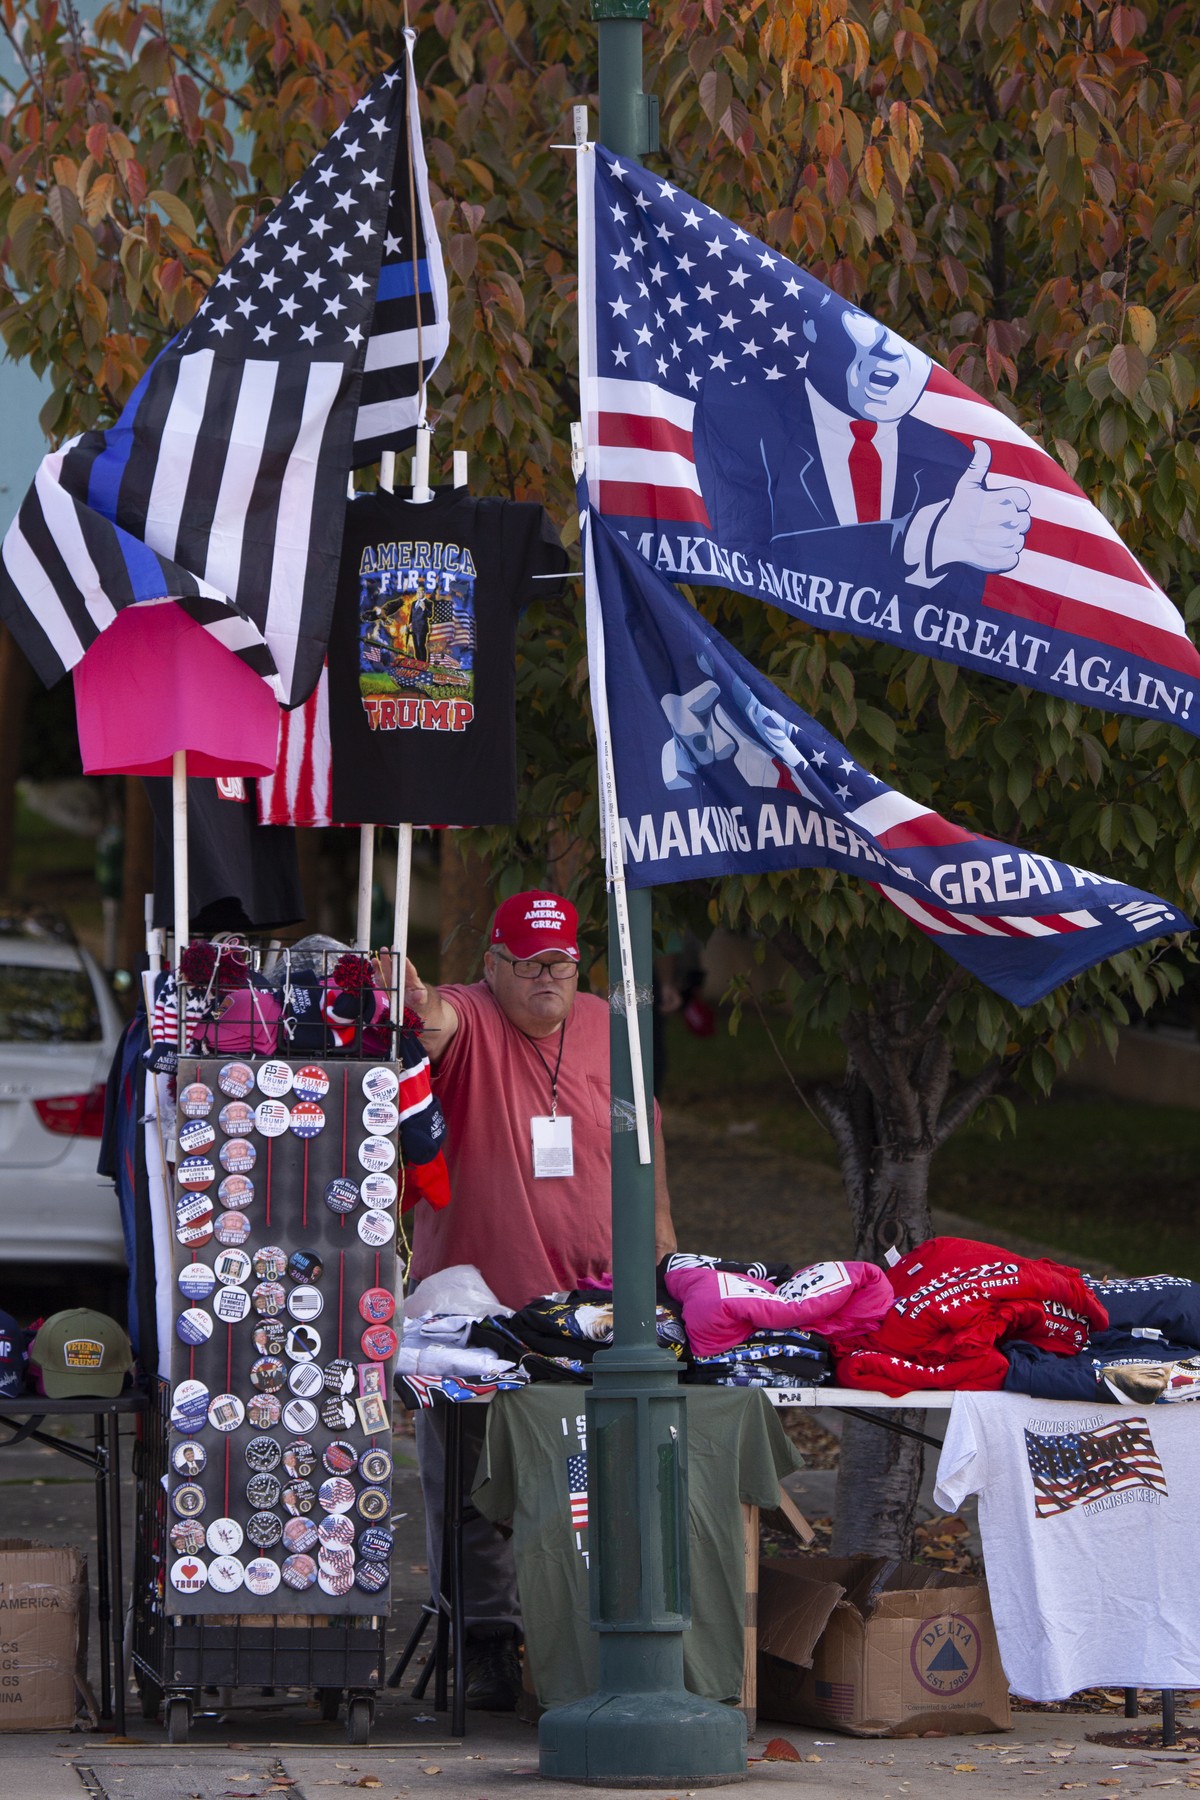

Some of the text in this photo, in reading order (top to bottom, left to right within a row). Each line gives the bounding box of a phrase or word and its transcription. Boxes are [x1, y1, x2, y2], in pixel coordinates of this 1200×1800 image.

[359, 541, 477, 577] AMERICA
[380, 570, 456, 594] FIRST
[758, 558, 902, 634] AMERICA
[913, 604, 1051, 675] GREAT
[1050, 648, 1194, 720] AGAIN!
[361, 697, 475, 731] TRUMP
[619, 804, 751, 864] MAKING
[930, 853, 1063, 905] GREAT
[532, 899, 557, 909] KEEP
[523, 909, 566, 921] AMERICA
[531, 919, 562, 930] GREAT
[263, 1076, 288, 1085] TRUMP
[296, 1076, 328, 1088] TRUMP
[372, 1087, 397, 1099] TRUMP
[181, 1126, 213, 1143] DEPLORABLE
[189, 1137, 211, 1149] MATTER
[362, 1157, 389, 1167] TRUMP
[332, 1185, 357, 1201] Trump
[345, 1182, 359, 1194] BLESS
[327, 1195, 341, 1204] Pence
[176, 1197, 208, 1216] DEPLORABLE
[186, 1207, 208, 1221] MATTER
[184, 1230, 207, 1241] MATTER
[360, 1227, 385, 1243] TRUMP
[221, 1276, 237, 1284] 2016
[291, 1270, 309, 1283] 2020
[909, 1276, 1019, 1320] KEEP AMERICA GREAT!
[196, 1312, 208, 1323] KFC
[263, 1324, 283, 1332] TRUMP
[67, 1341, 101, 1351] VETERAN
[67, 1358, 100, 1367] TRUMP
[181, 1384, 195, 1394] KFC
[324, 1380, 342, 1388] GUNS
[327, 1396, 344, 1405] GIRLS
[321, 1409, 338, 1417] WANNA
[324, 1415, 340, 1423] HAVE
[224, 1421, 239, 1431] 2016
[327, 1419, 345, 1427] GUNS
[1027, 1414, 1105, 1434] PROMISES MADE
[1037, 1426, 1142, 1478] TRUMP
[1072, 1459, 1131, 1497] 2020
[291, 1481, 310, 1490] TRUMP
[1083, 1488, 1162, 1517] PROMISES KEPT
[365, 1534, 391, 1549] Trump
[378, 1530, 393, 1541] BLESS
[361, 1545, 376, 1554] Pence
[363, 1562, 386, 1582] Trump
[377, 1562, 390, 1577] BLESS
[175, 1580, 204, 1588] TRUMP
[356, 1571, 380, 1590] Pence 2020
[0, 1597, 60, 1610] AMERICA
[922, 1619, 973, 1648] DELTA
[0, 1659, 20, 1670] GS
[2, 1676, 20, 1687] GS
[926, 1670, 970, 1690] EST. 1903
[905, 1702, 939, 1711] "Committed
[948, 1702, 967, 1710] Global
[968, 1701, 985, 1710] Safety"
